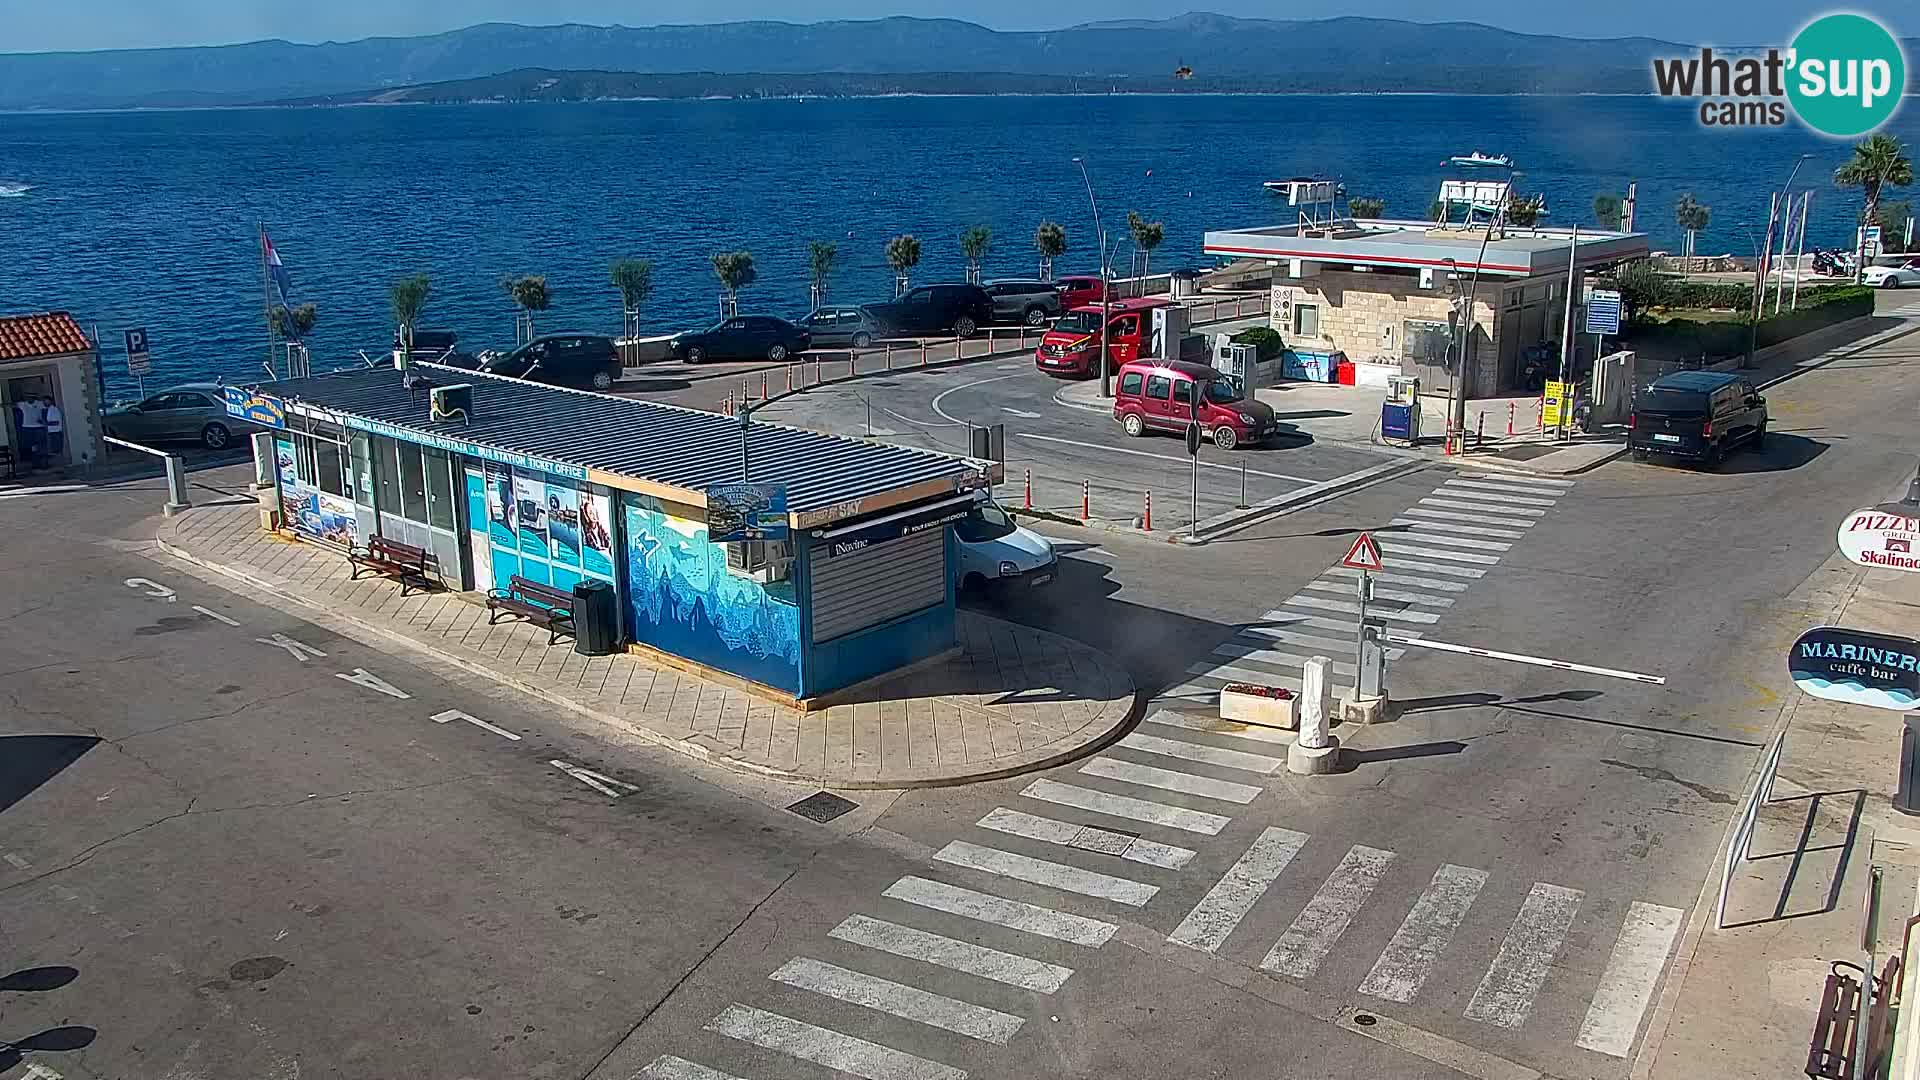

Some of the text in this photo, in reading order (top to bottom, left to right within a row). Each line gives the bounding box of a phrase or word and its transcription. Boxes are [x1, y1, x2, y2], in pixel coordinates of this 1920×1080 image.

[130, 332, 142, 350] P
[436, 438, 468, 453] POSTAJA
[478, 446, 492, 457] BUS
[494, 449, 527, 466] STATION
[529, 457, 554, 472] TICKET
[556, 463, 583, 478] OFFICE
[1848, 515, 1920, 533] PIZZE
[1882, 531, 1919, 541] GRILL
[1829, 662, 1898, 681] caffe bar
